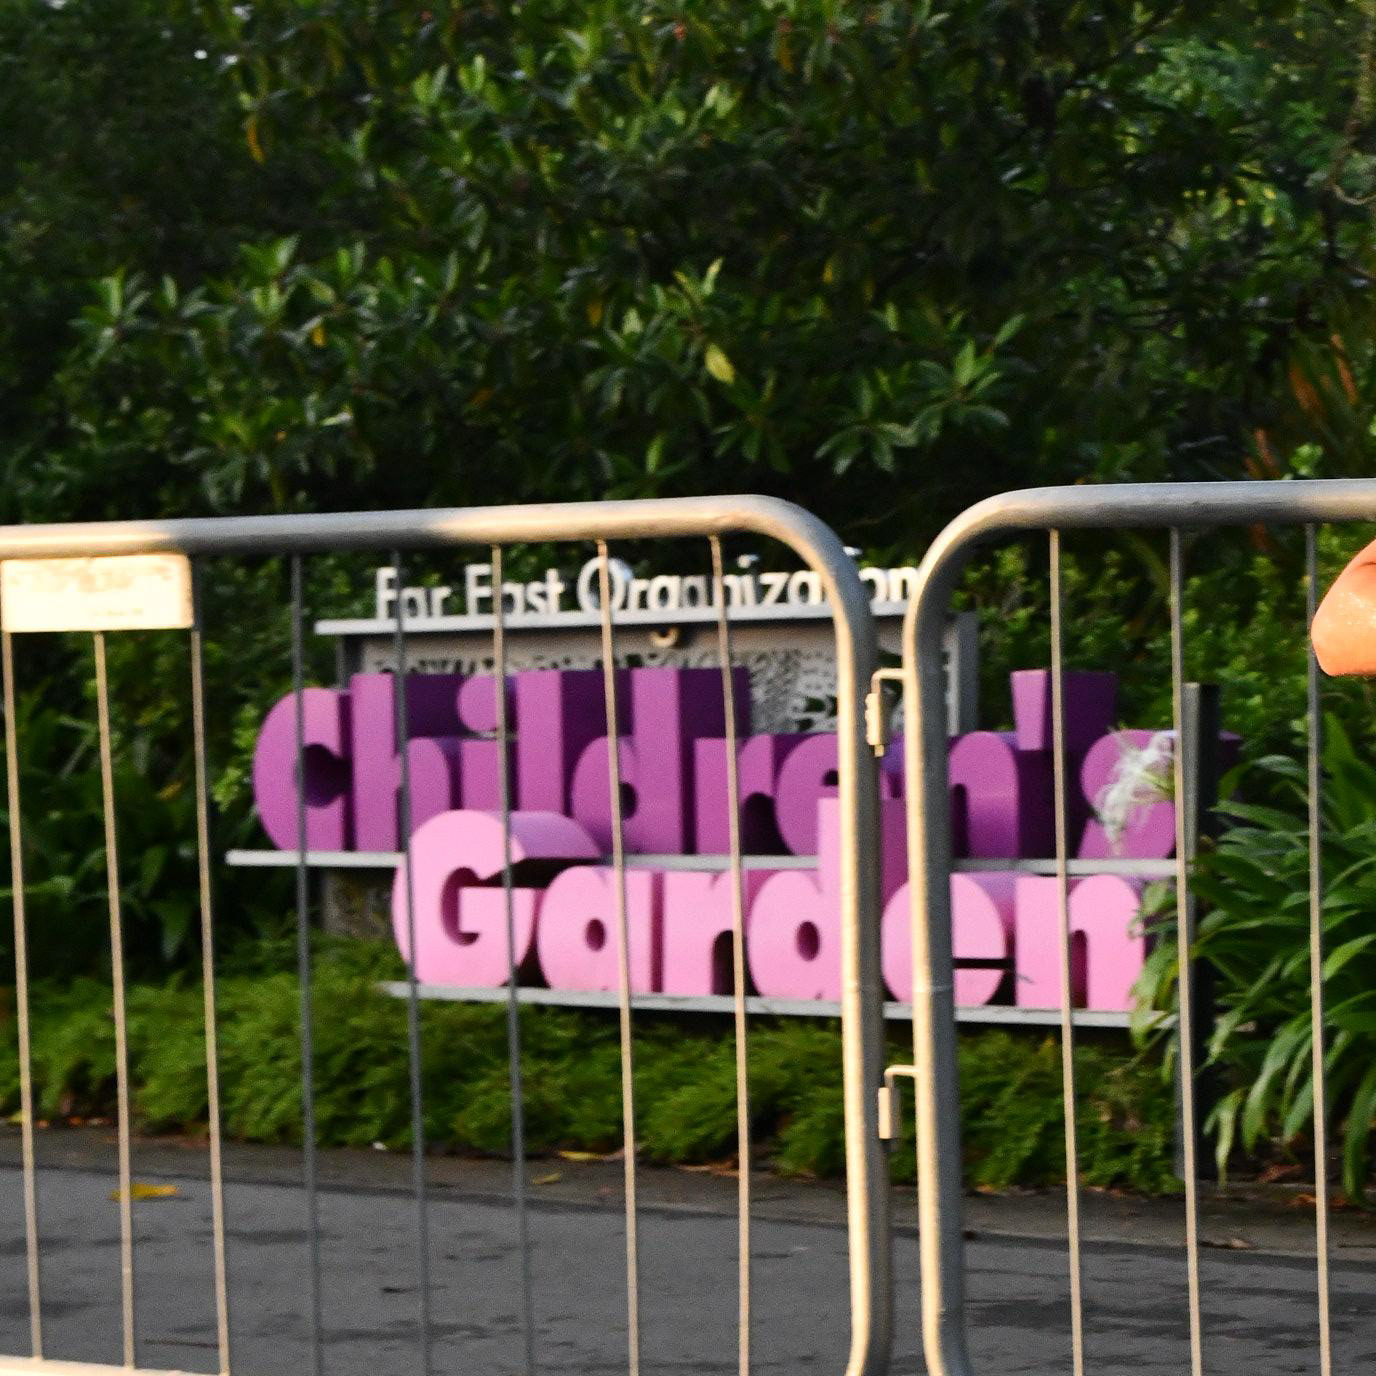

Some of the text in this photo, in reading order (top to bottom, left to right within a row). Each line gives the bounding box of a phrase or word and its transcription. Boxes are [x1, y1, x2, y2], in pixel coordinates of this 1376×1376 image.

[375, 546, 922, 630] Far East Organizaon
[394, 796, 1148, 1012] Garden
